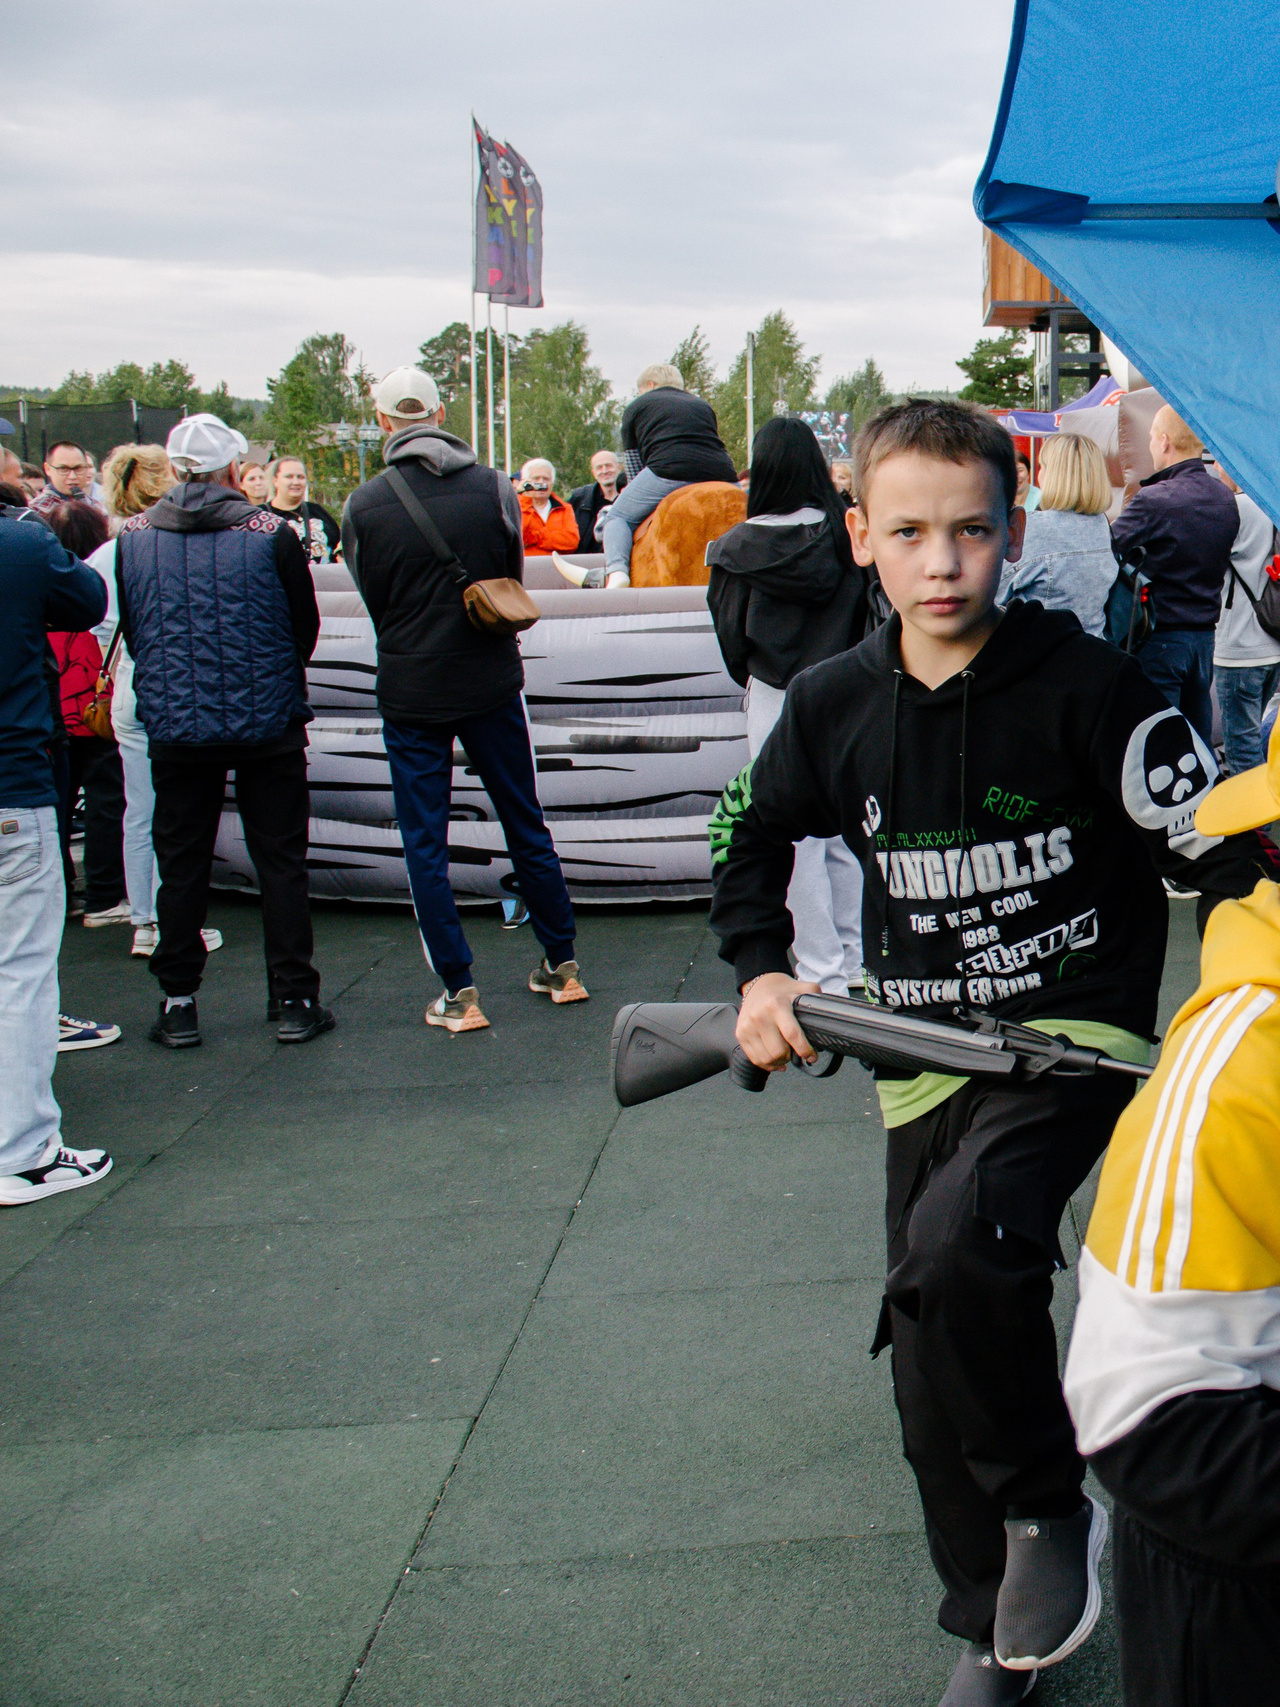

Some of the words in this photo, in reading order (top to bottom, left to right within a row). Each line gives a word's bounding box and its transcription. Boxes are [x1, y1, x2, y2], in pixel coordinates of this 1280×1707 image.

[909, 914, 940, 934] THE
[945, 906, 983, 928] NEW
[991, 890, 1039, 917] COOL
[962, 925, 1001, 949] 1988
[883, 978, 962, 1007] SYSTEM
[967, 972, 1042, 1006] ERROR
